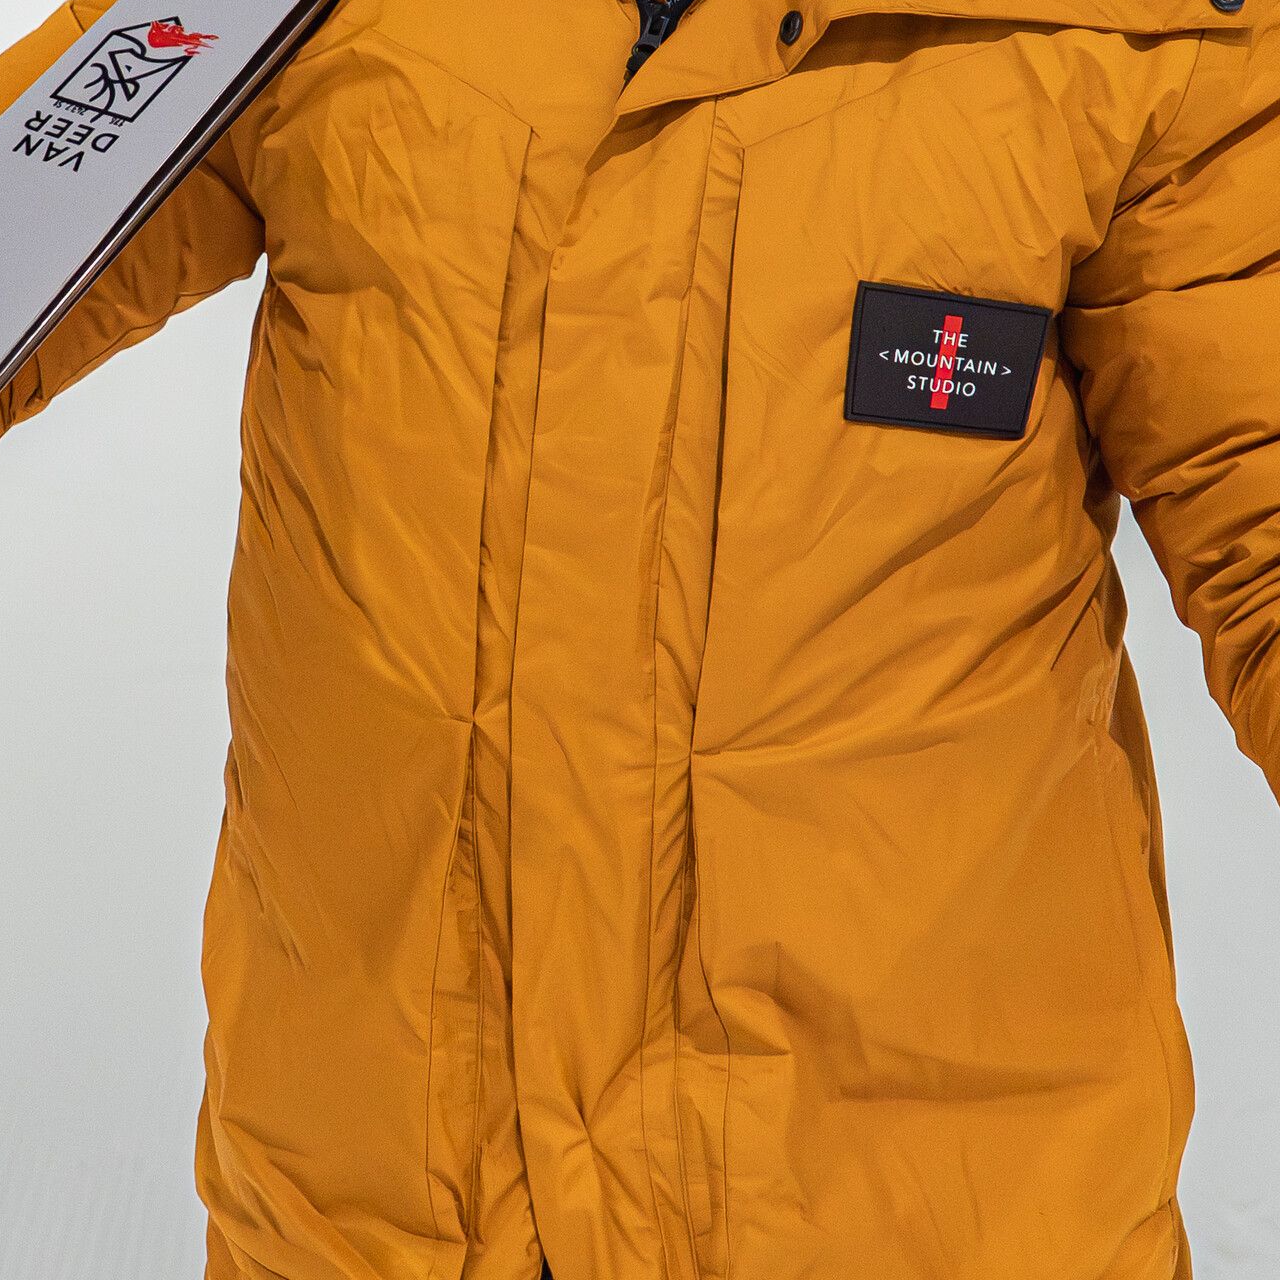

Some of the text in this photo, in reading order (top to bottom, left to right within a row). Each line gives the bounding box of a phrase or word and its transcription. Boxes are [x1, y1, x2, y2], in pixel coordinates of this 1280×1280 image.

[24, 110, 120, 153] DEER
[12, 133, 85, 172] VAN
[932, 329, 969, 349] THE
[906, 375, 977, 397] STUDIO
